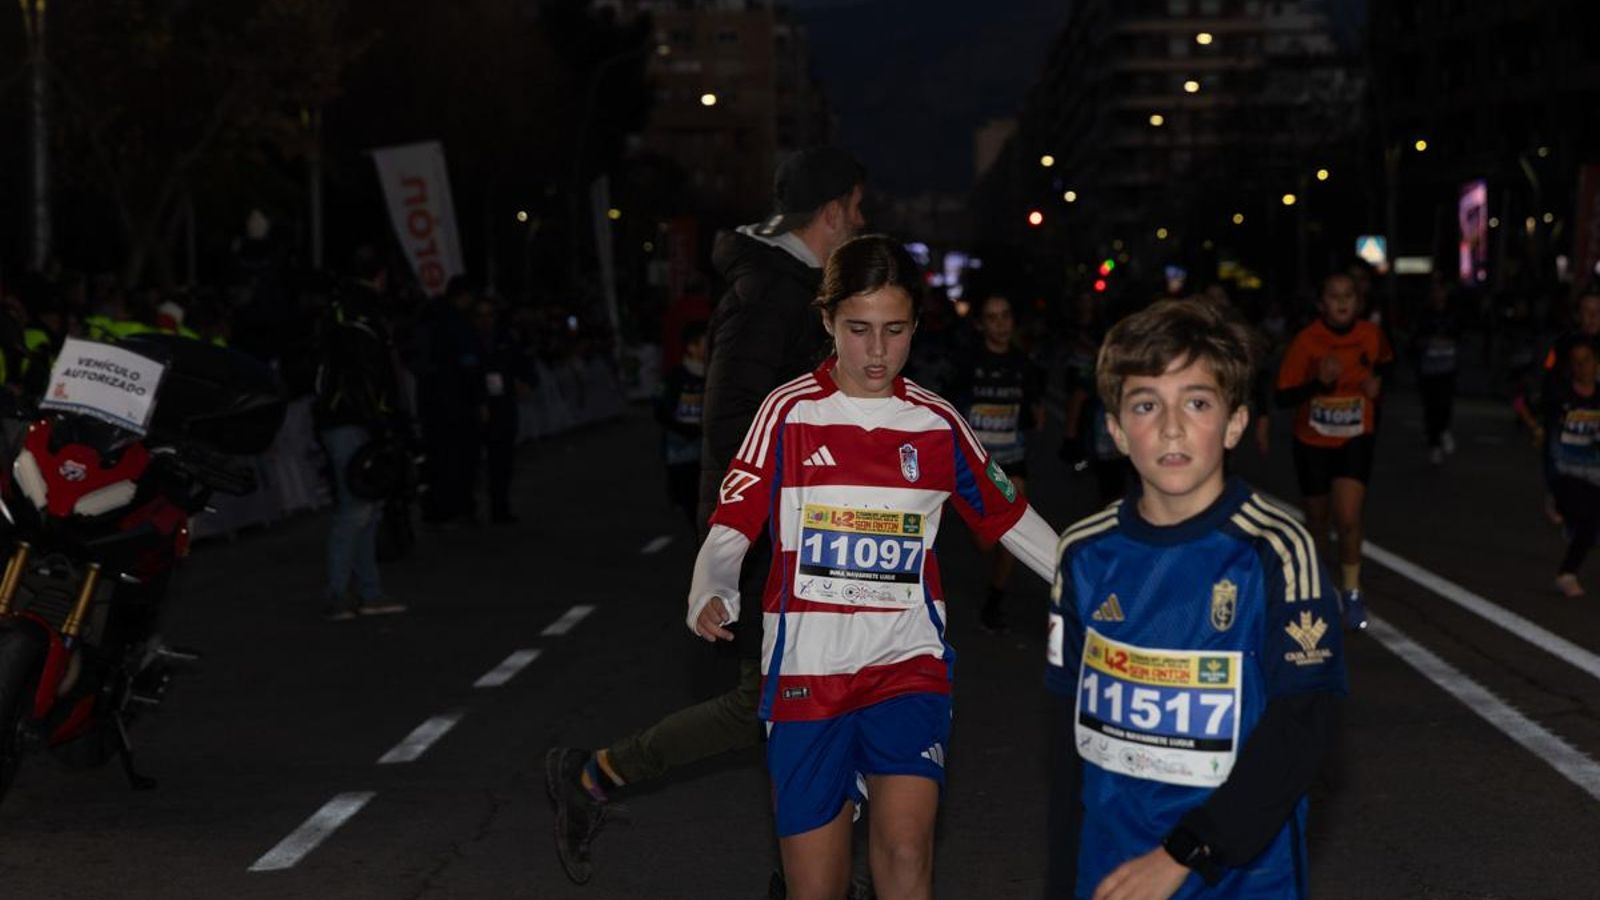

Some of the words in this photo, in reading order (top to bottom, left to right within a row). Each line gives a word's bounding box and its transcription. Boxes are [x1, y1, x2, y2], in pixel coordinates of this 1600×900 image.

[63, 367, 147, 396] AUTORIZADO
[831, 511, 855, 529] 42
[804, 532, 922, 570] 11097
[1104, 647, 1128, 672] 42
[1082, 672, 1234, 735] 11517
